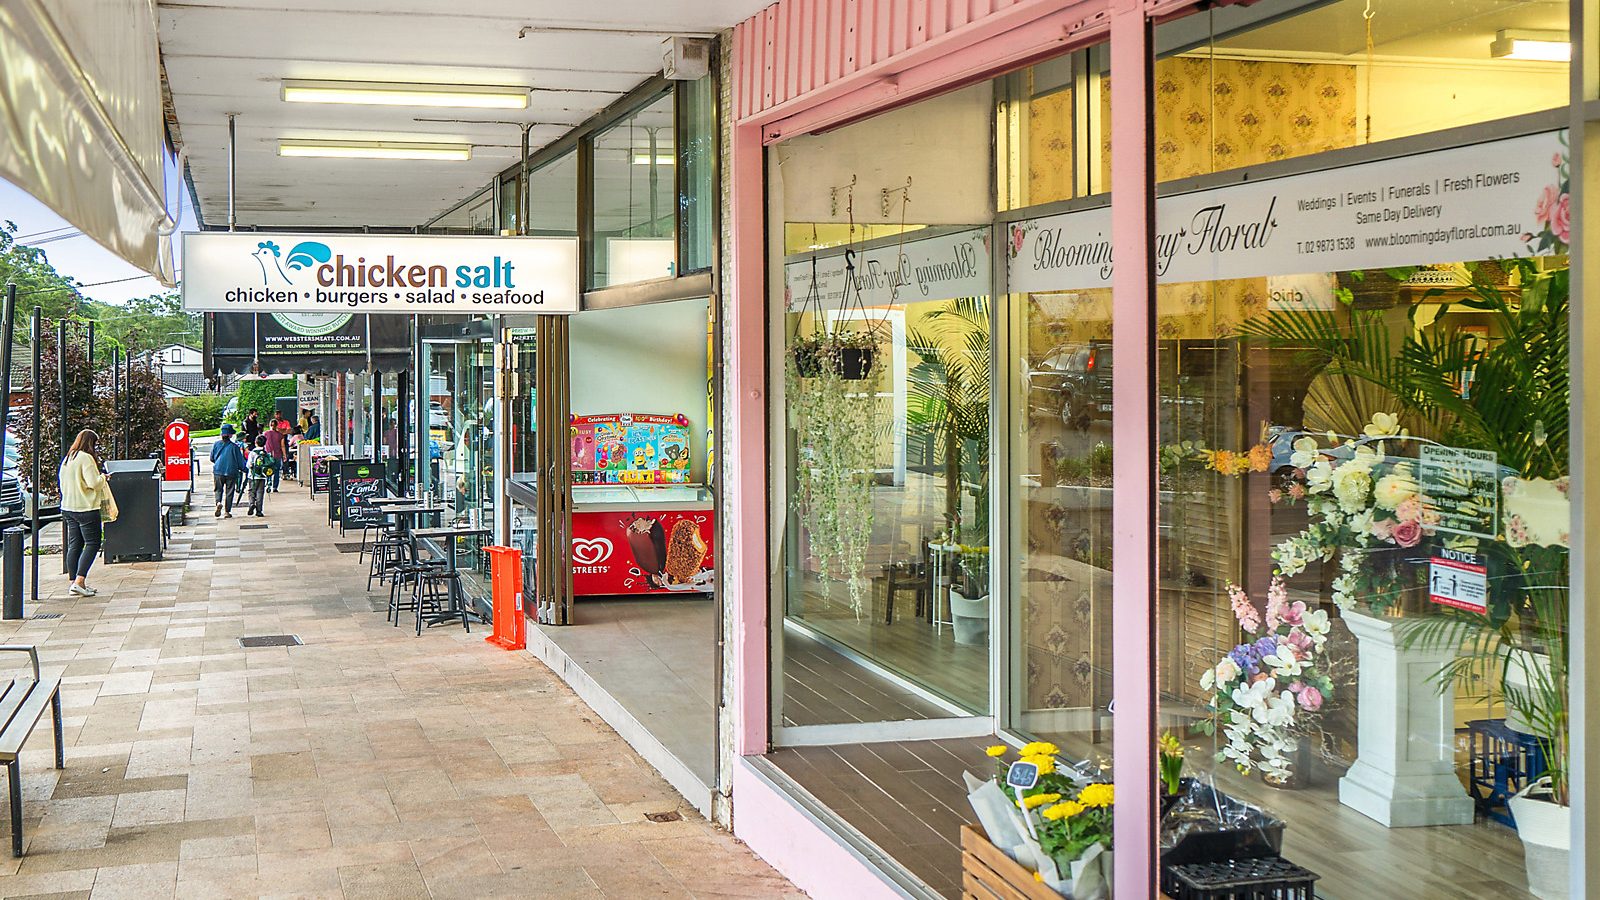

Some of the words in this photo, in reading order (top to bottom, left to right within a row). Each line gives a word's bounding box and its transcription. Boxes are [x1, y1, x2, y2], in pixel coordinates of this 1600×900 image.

[1298, 198, 1337, 211] Weddings
[1347, 192, 1377, 206] Events
[1389, 182, 1431, 199] Funerals
[1443, 176, 1473, 192] Fresh
[1476, 171, 1520, 188] Flowers
[1356, 212, 1382, 225] Same
[1383, 208, 1402, 223] Day
[1403, 204, 1442, 219] Delivery
[1156, 228, 1186, 277] ay
[1187, 196, 1278, 255] Floral
[1305, 241, 1315, 254] 02
[1316, 239, 1336, 252] 9873
[1337, 237, 1356, 251] 1538
[1365, 223, 1521, 248] www.bloomingdayfloral.com.au
[317, 254, 448, 288] chicken
[455, 256, 516, 289] salt
[225, 287, 298, 303] chicken
[316, 288, 388, 307] burgers
[405, 289, 455, 304] salad
[472, 290, 544, 305] seafood
[286, 322, 304, 333] AWARD
[305, 326, 332, 334] WINNING
[167, 457, 190, 465] POST
[1463, 449, 1494, 462] HOURS
[346, 479, 379, 498] Lamb
[1441, 548, 1477, 565] NOTICE
[572, 566, 608, 574] STREETS
